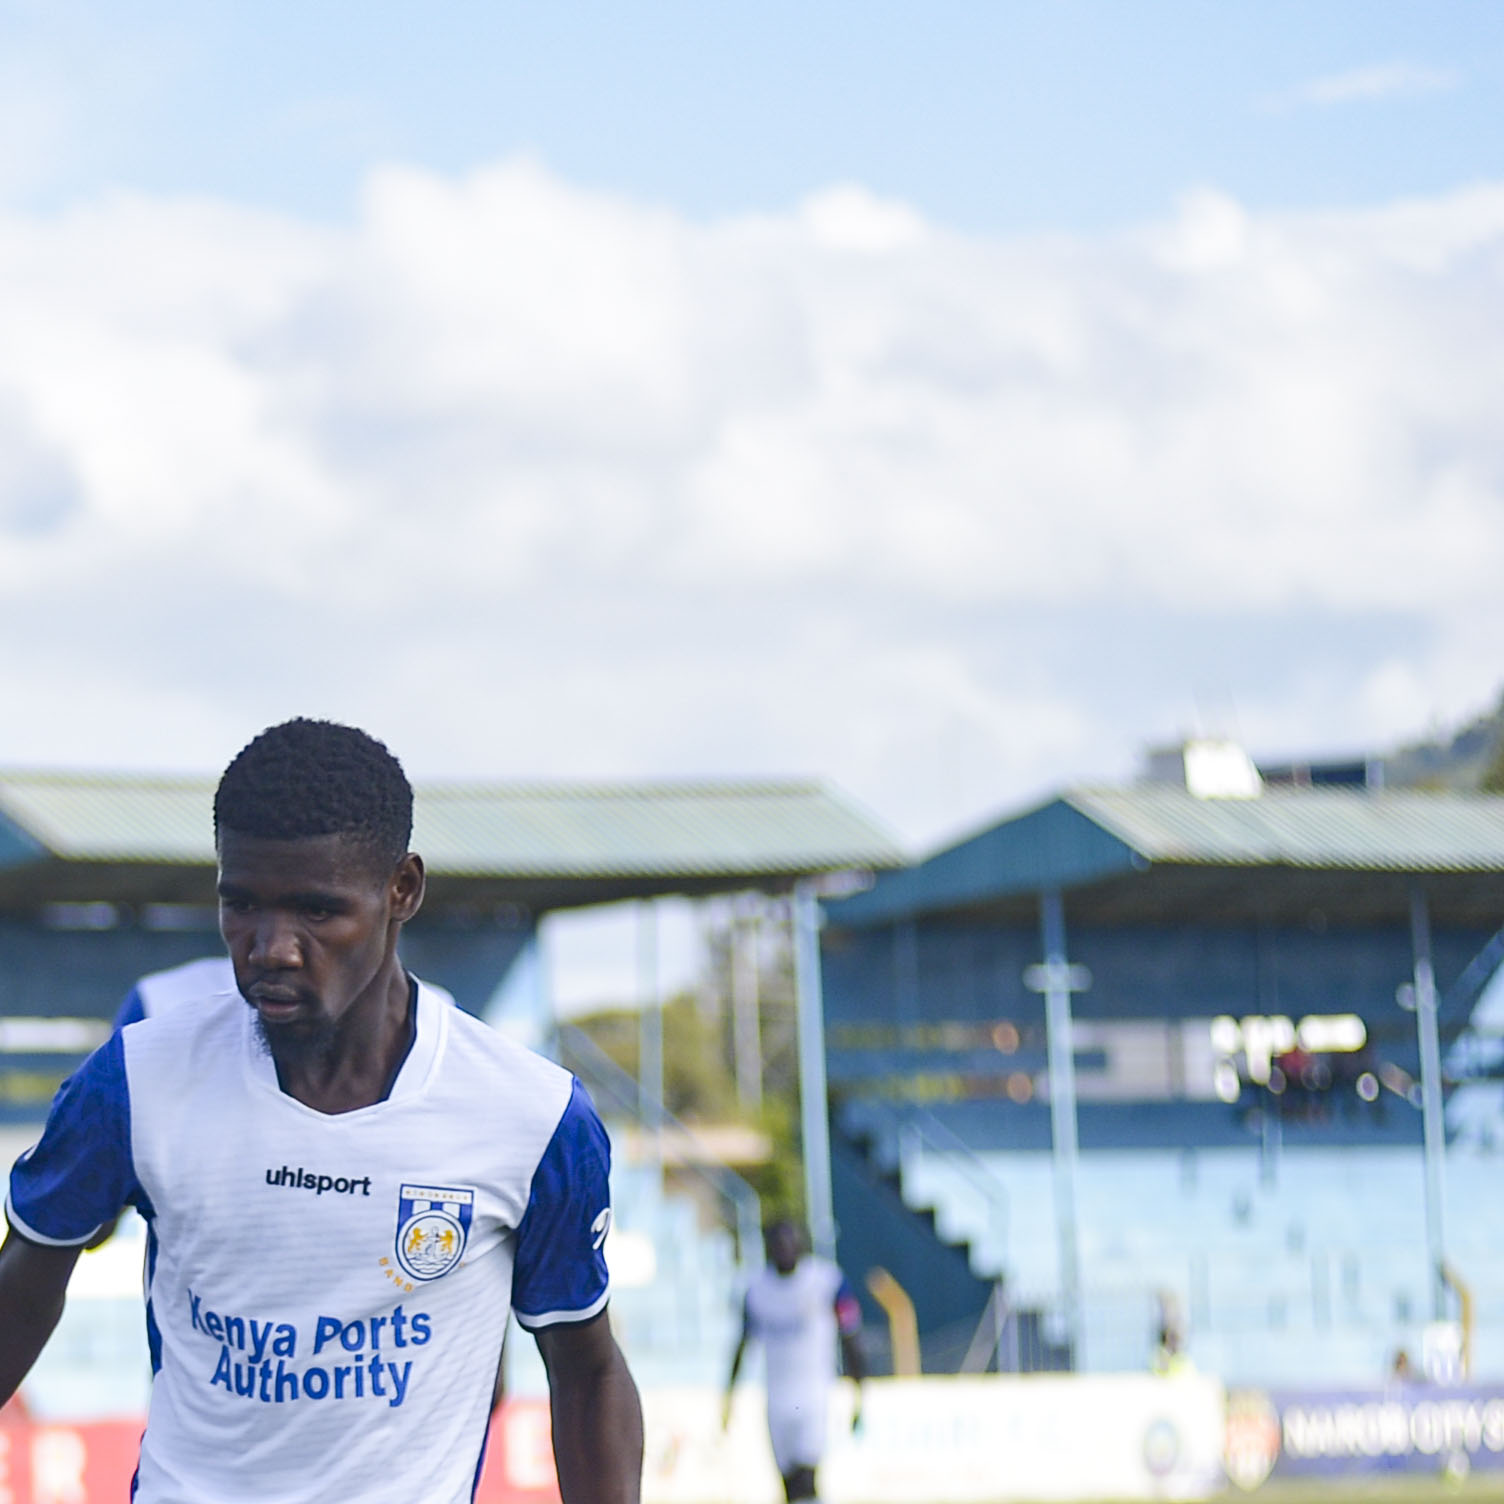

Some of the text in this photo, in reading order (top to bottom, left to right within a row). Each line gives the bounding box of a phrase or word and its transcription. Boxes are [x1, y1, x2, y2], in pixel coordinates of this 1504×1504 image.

[266, 1166, 372, 1196] uhlsport
[188, 1288, 432, 1364] Kenya Ports
[210, 1344, 414, 1408] Authority
